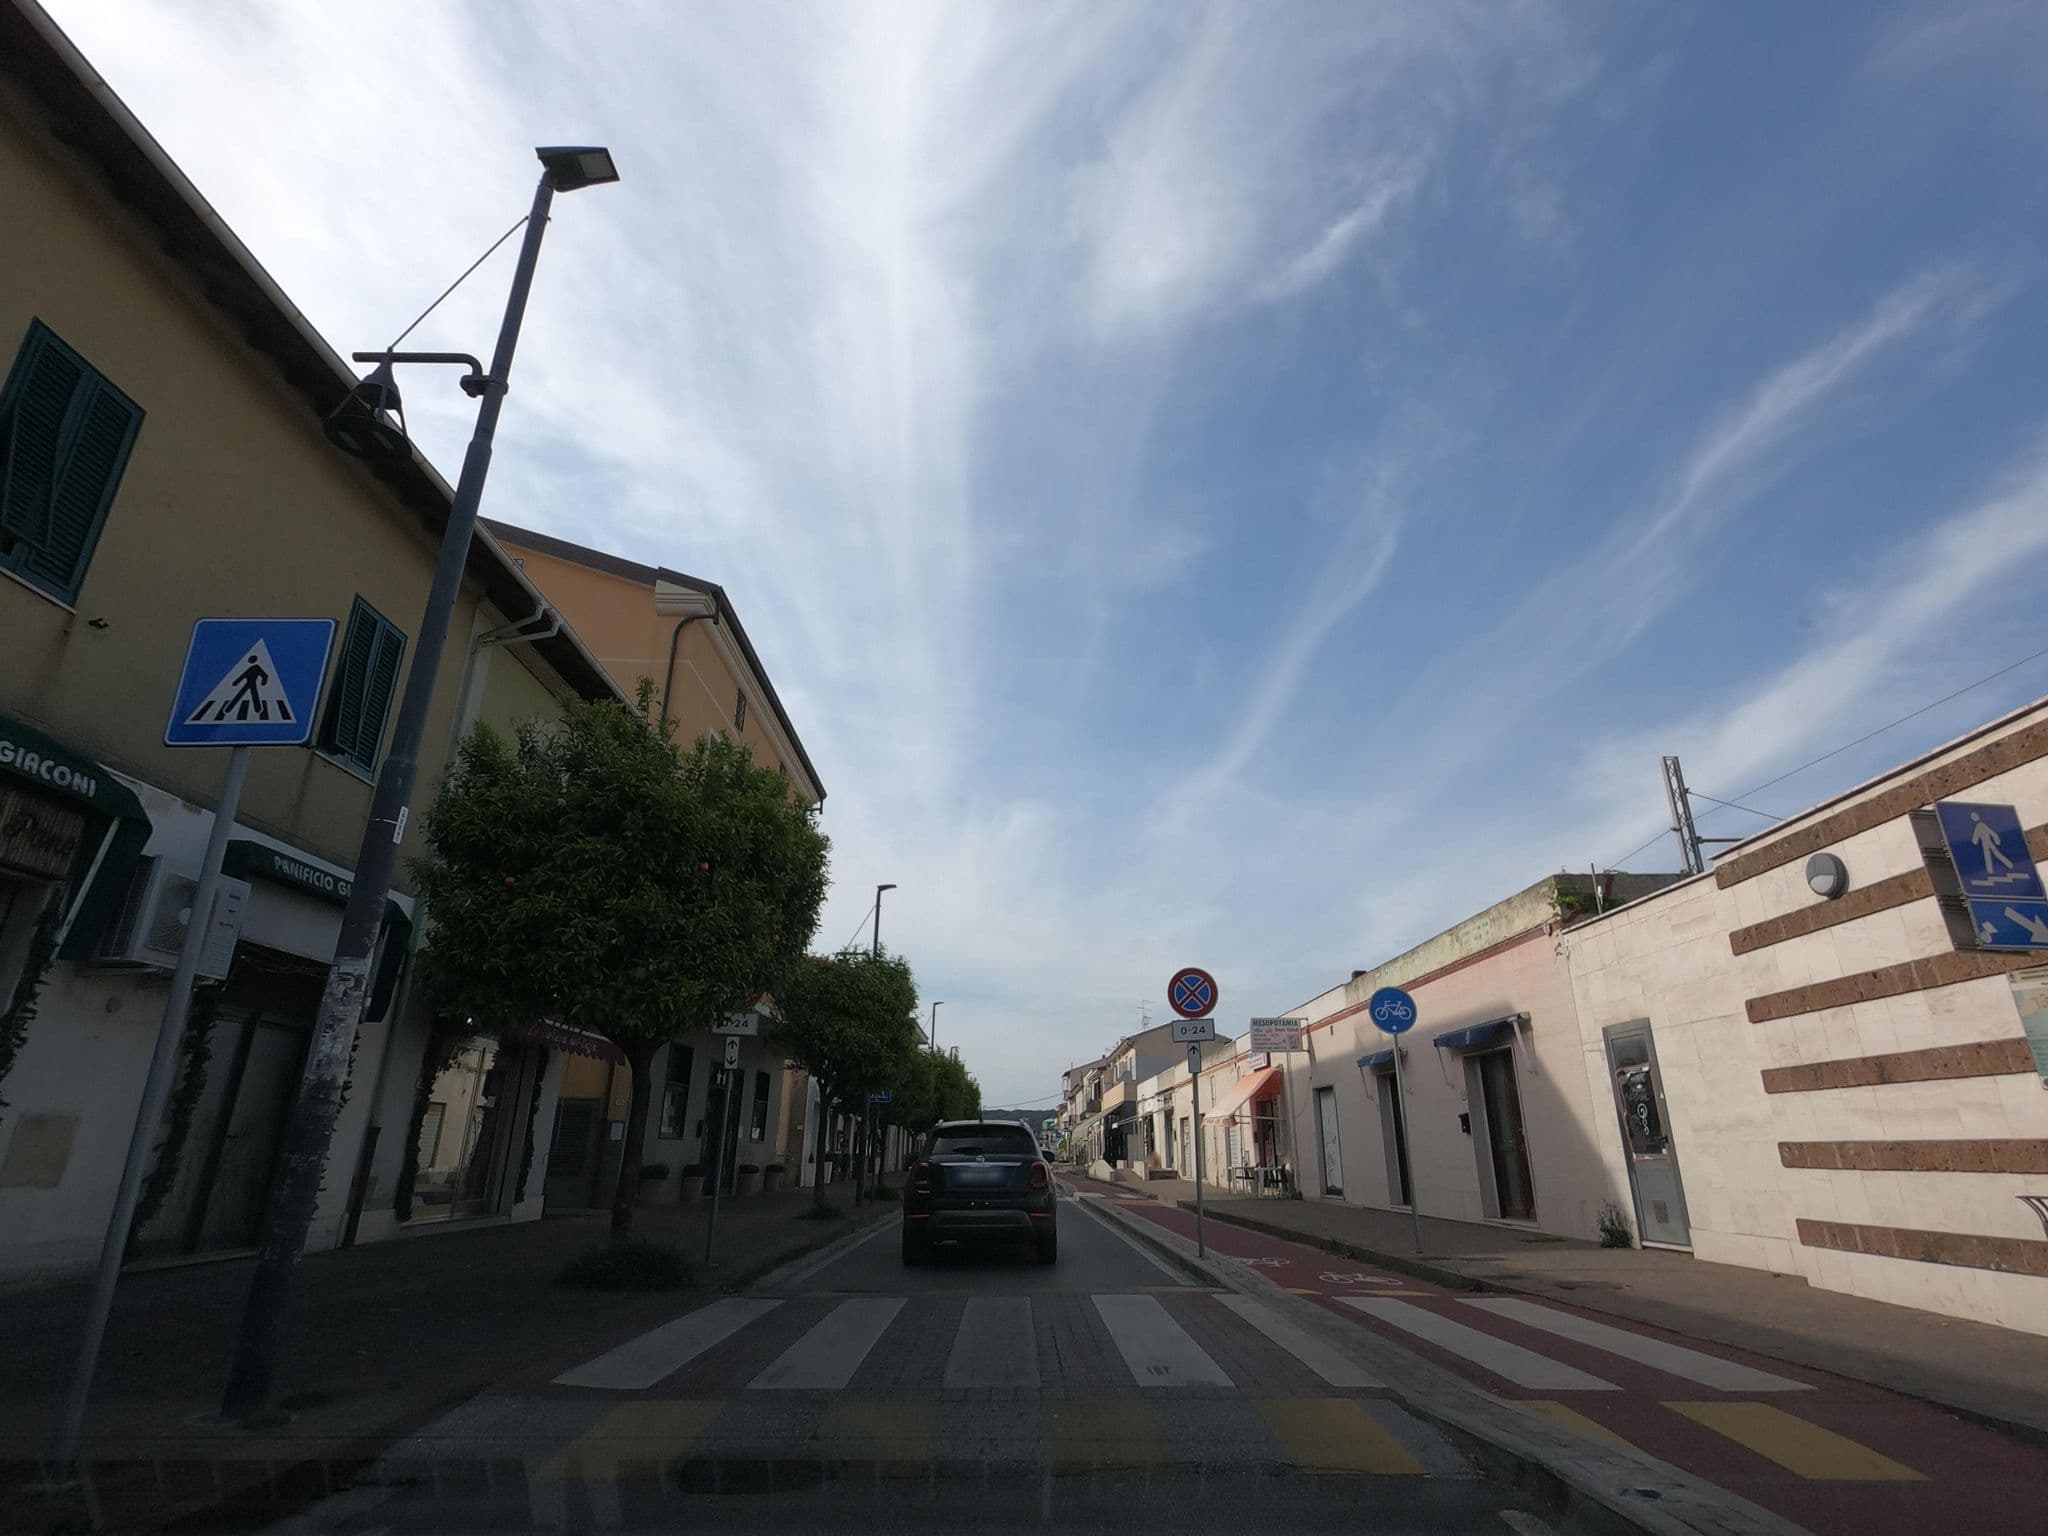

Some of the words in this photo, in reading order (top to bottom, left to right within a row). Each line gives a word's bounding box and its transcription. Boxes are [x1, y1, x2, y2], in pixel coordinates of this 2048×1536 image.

[0, 740, 97, 798] GIACONI
[273, 855, 334, 890] PANIFICIO
[1180, 1025, 1206, 1036] 0-24
[1253, 1019, 1299, 1027] MESOPOTAMIA
